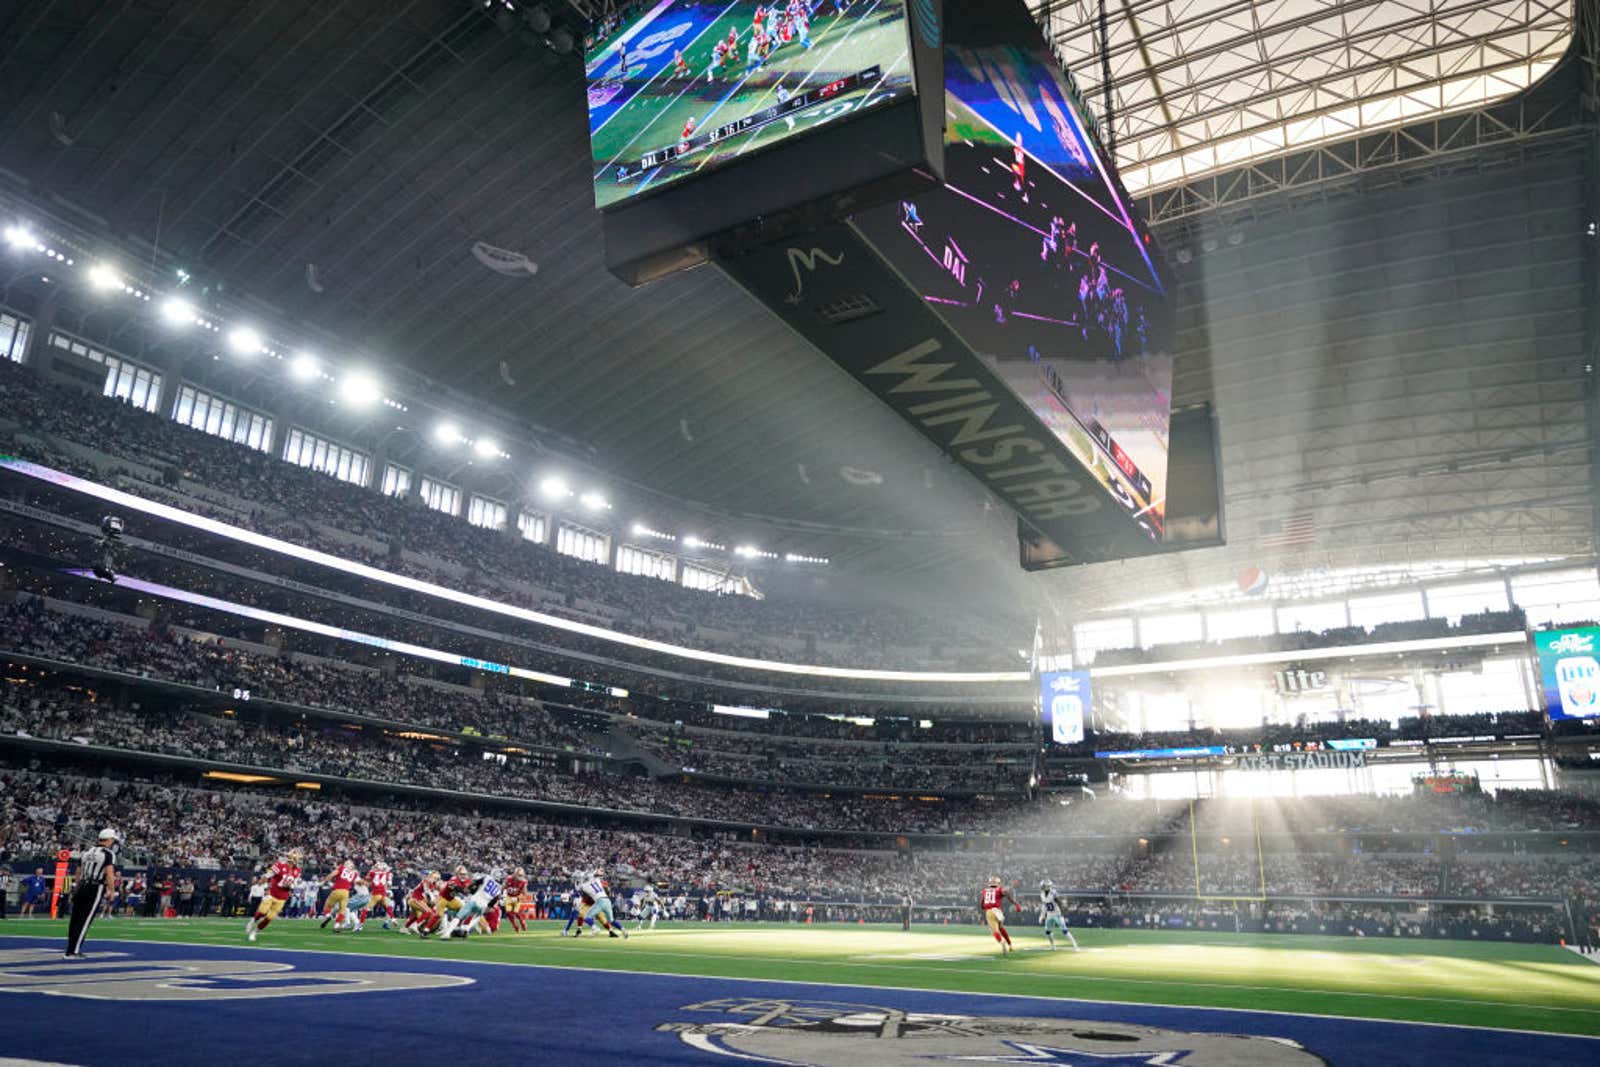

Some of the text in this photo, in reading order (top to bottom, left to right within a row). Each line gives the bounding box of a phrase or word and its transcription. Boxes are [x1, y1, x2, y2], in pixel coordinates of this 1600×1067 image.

[708, 127, 719, 142] SF
[641, 152, 657, 170] DAL
[943, 244, 967, 287] DAL
[862, 336, 1102, 521] WINSTAR
[1239, 751, 1366, 770] AT&T STADIUM
[340, 868, 355, 882] 60
[372, 871, 387, 886] 44
[483, 879, 499, 897] 90
[590, 881, 602, 894] 11
